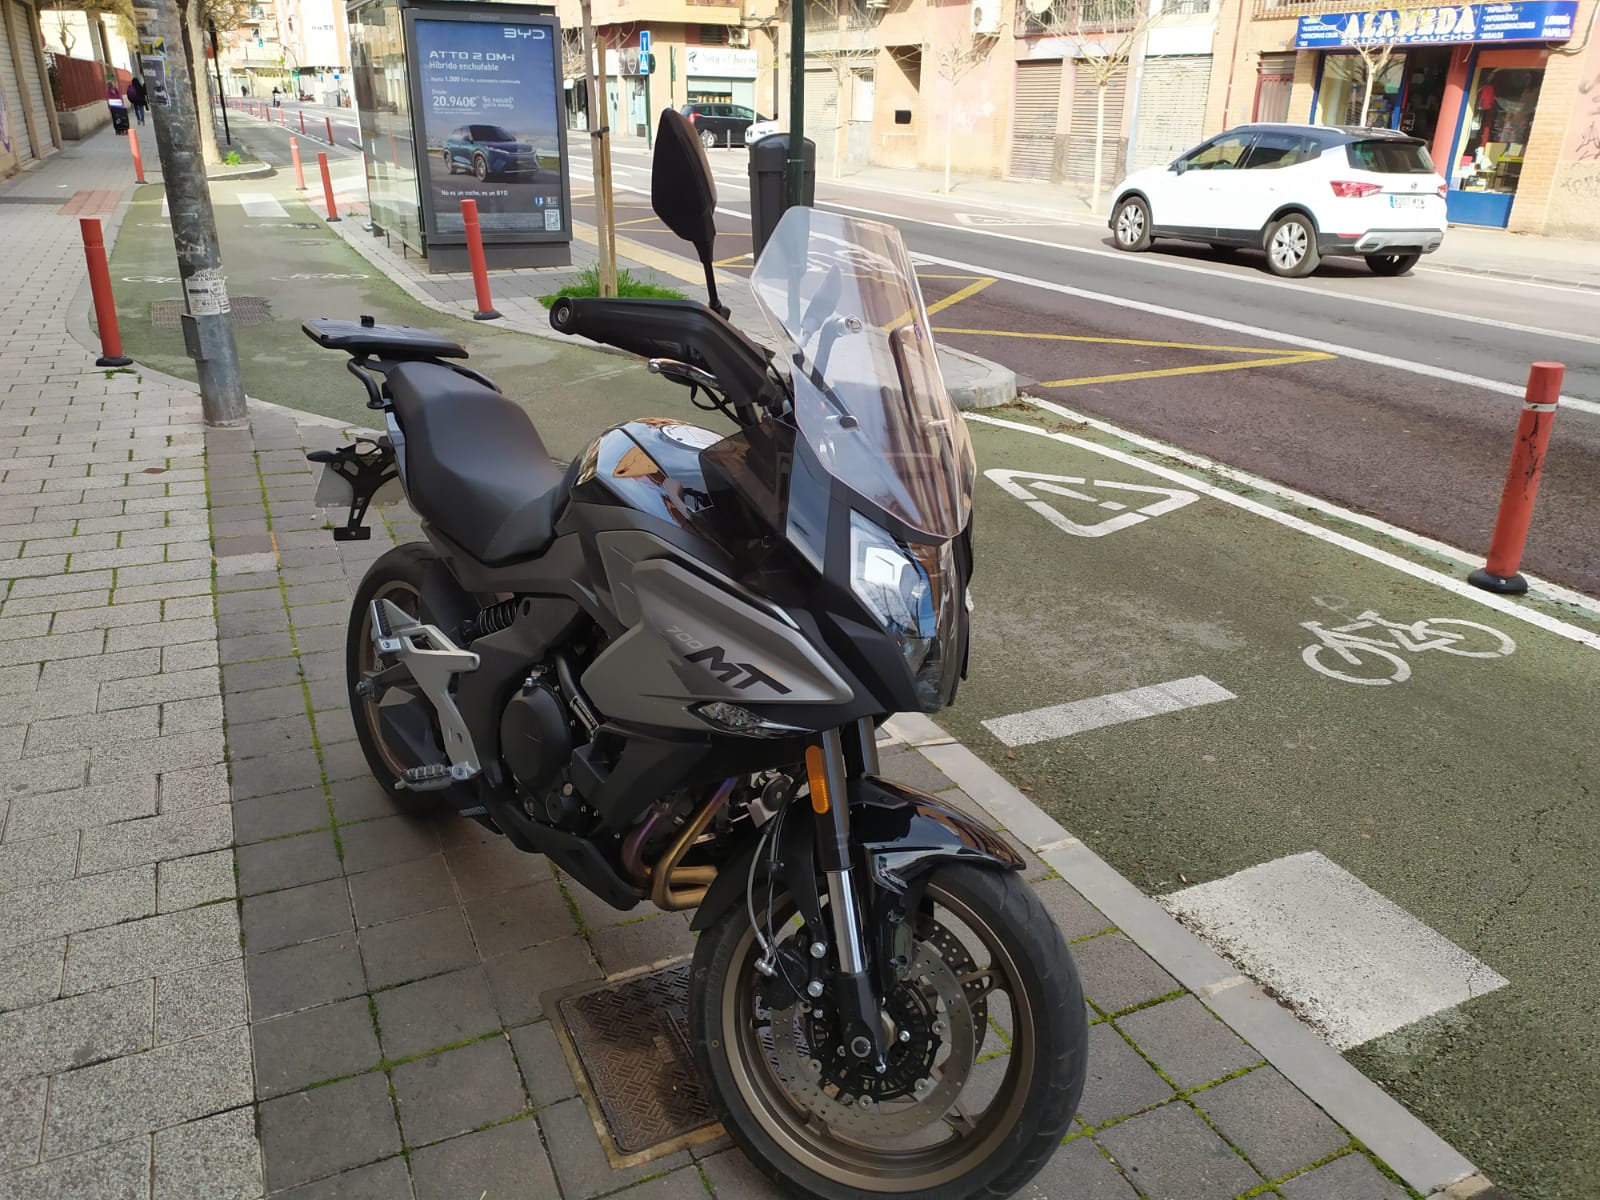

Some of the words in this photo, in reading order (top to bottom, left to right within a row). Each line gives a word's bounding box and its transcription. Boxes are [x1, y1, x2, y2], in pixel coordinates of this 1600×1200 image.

[1344, 6, 1476, 39] ALAMEDA
[503, 27, 546, 40] BYD
[1410, 33, 1474, 42] CAUCHO
[429, 50, 469, 60] ATTO
[472, 52, 483, 61] 2
[486, 52, 515, 62] DM-i
[429, 60, 457, 70] Híbrido
[458, 62, 500, 71] enchufable
[432, 95, 477, 108] 20.940€
[666, 625, 704, 650] 700
[683, 645, 793, 695] MT
